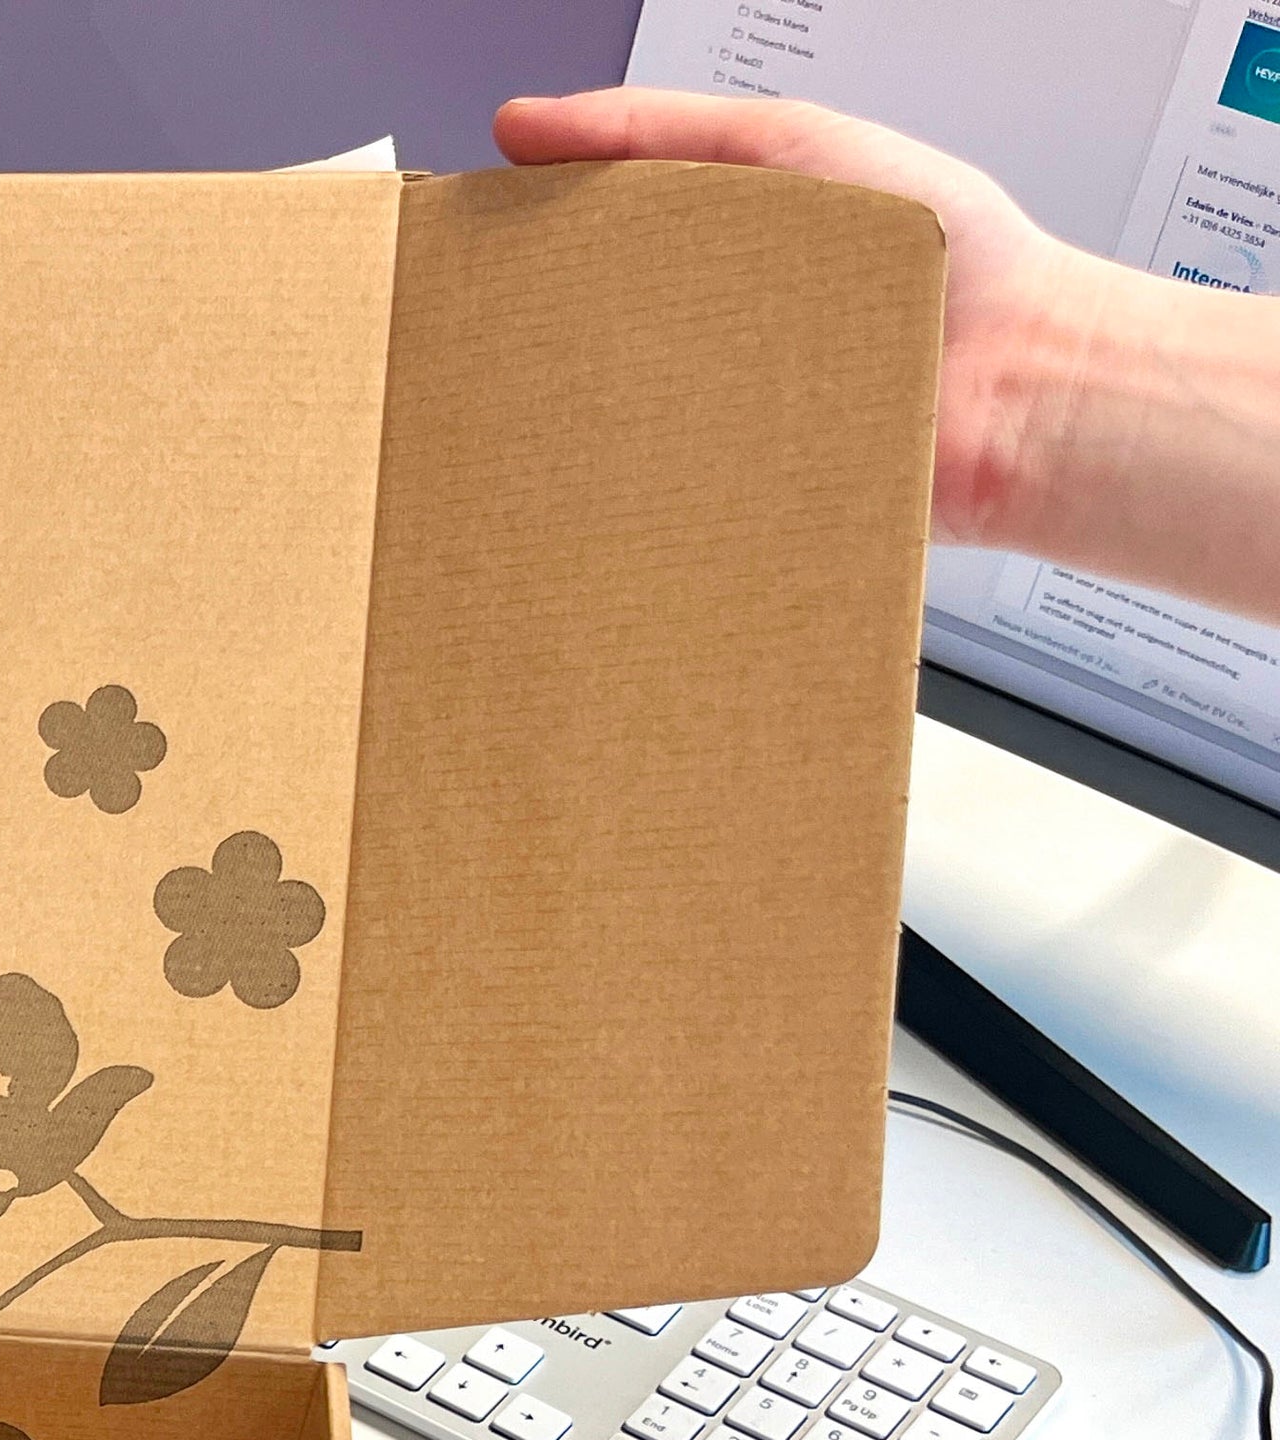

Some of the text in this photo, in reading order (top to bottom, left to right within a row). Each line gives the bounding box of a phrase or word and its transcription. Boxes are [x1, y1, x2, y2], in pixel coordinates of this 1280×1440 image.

[1197, 164, 1218, 179] Met
[1216, 208, 1229, 219] de
[745, 1300, 773, 1315] Lock
[705, 1338, 739, 1357] Home
[795, 1359, 809, 1370] 8
[693, 1368, 707, 1378] 4
[863, 1389, 877, 1401] 9
[661, 1405, 670, 1415] 1
[759, 1398, 774, 1410] 5
[842, 1398, 877, 1420] Pg Up
[642, 1417, 666, 1433] End
